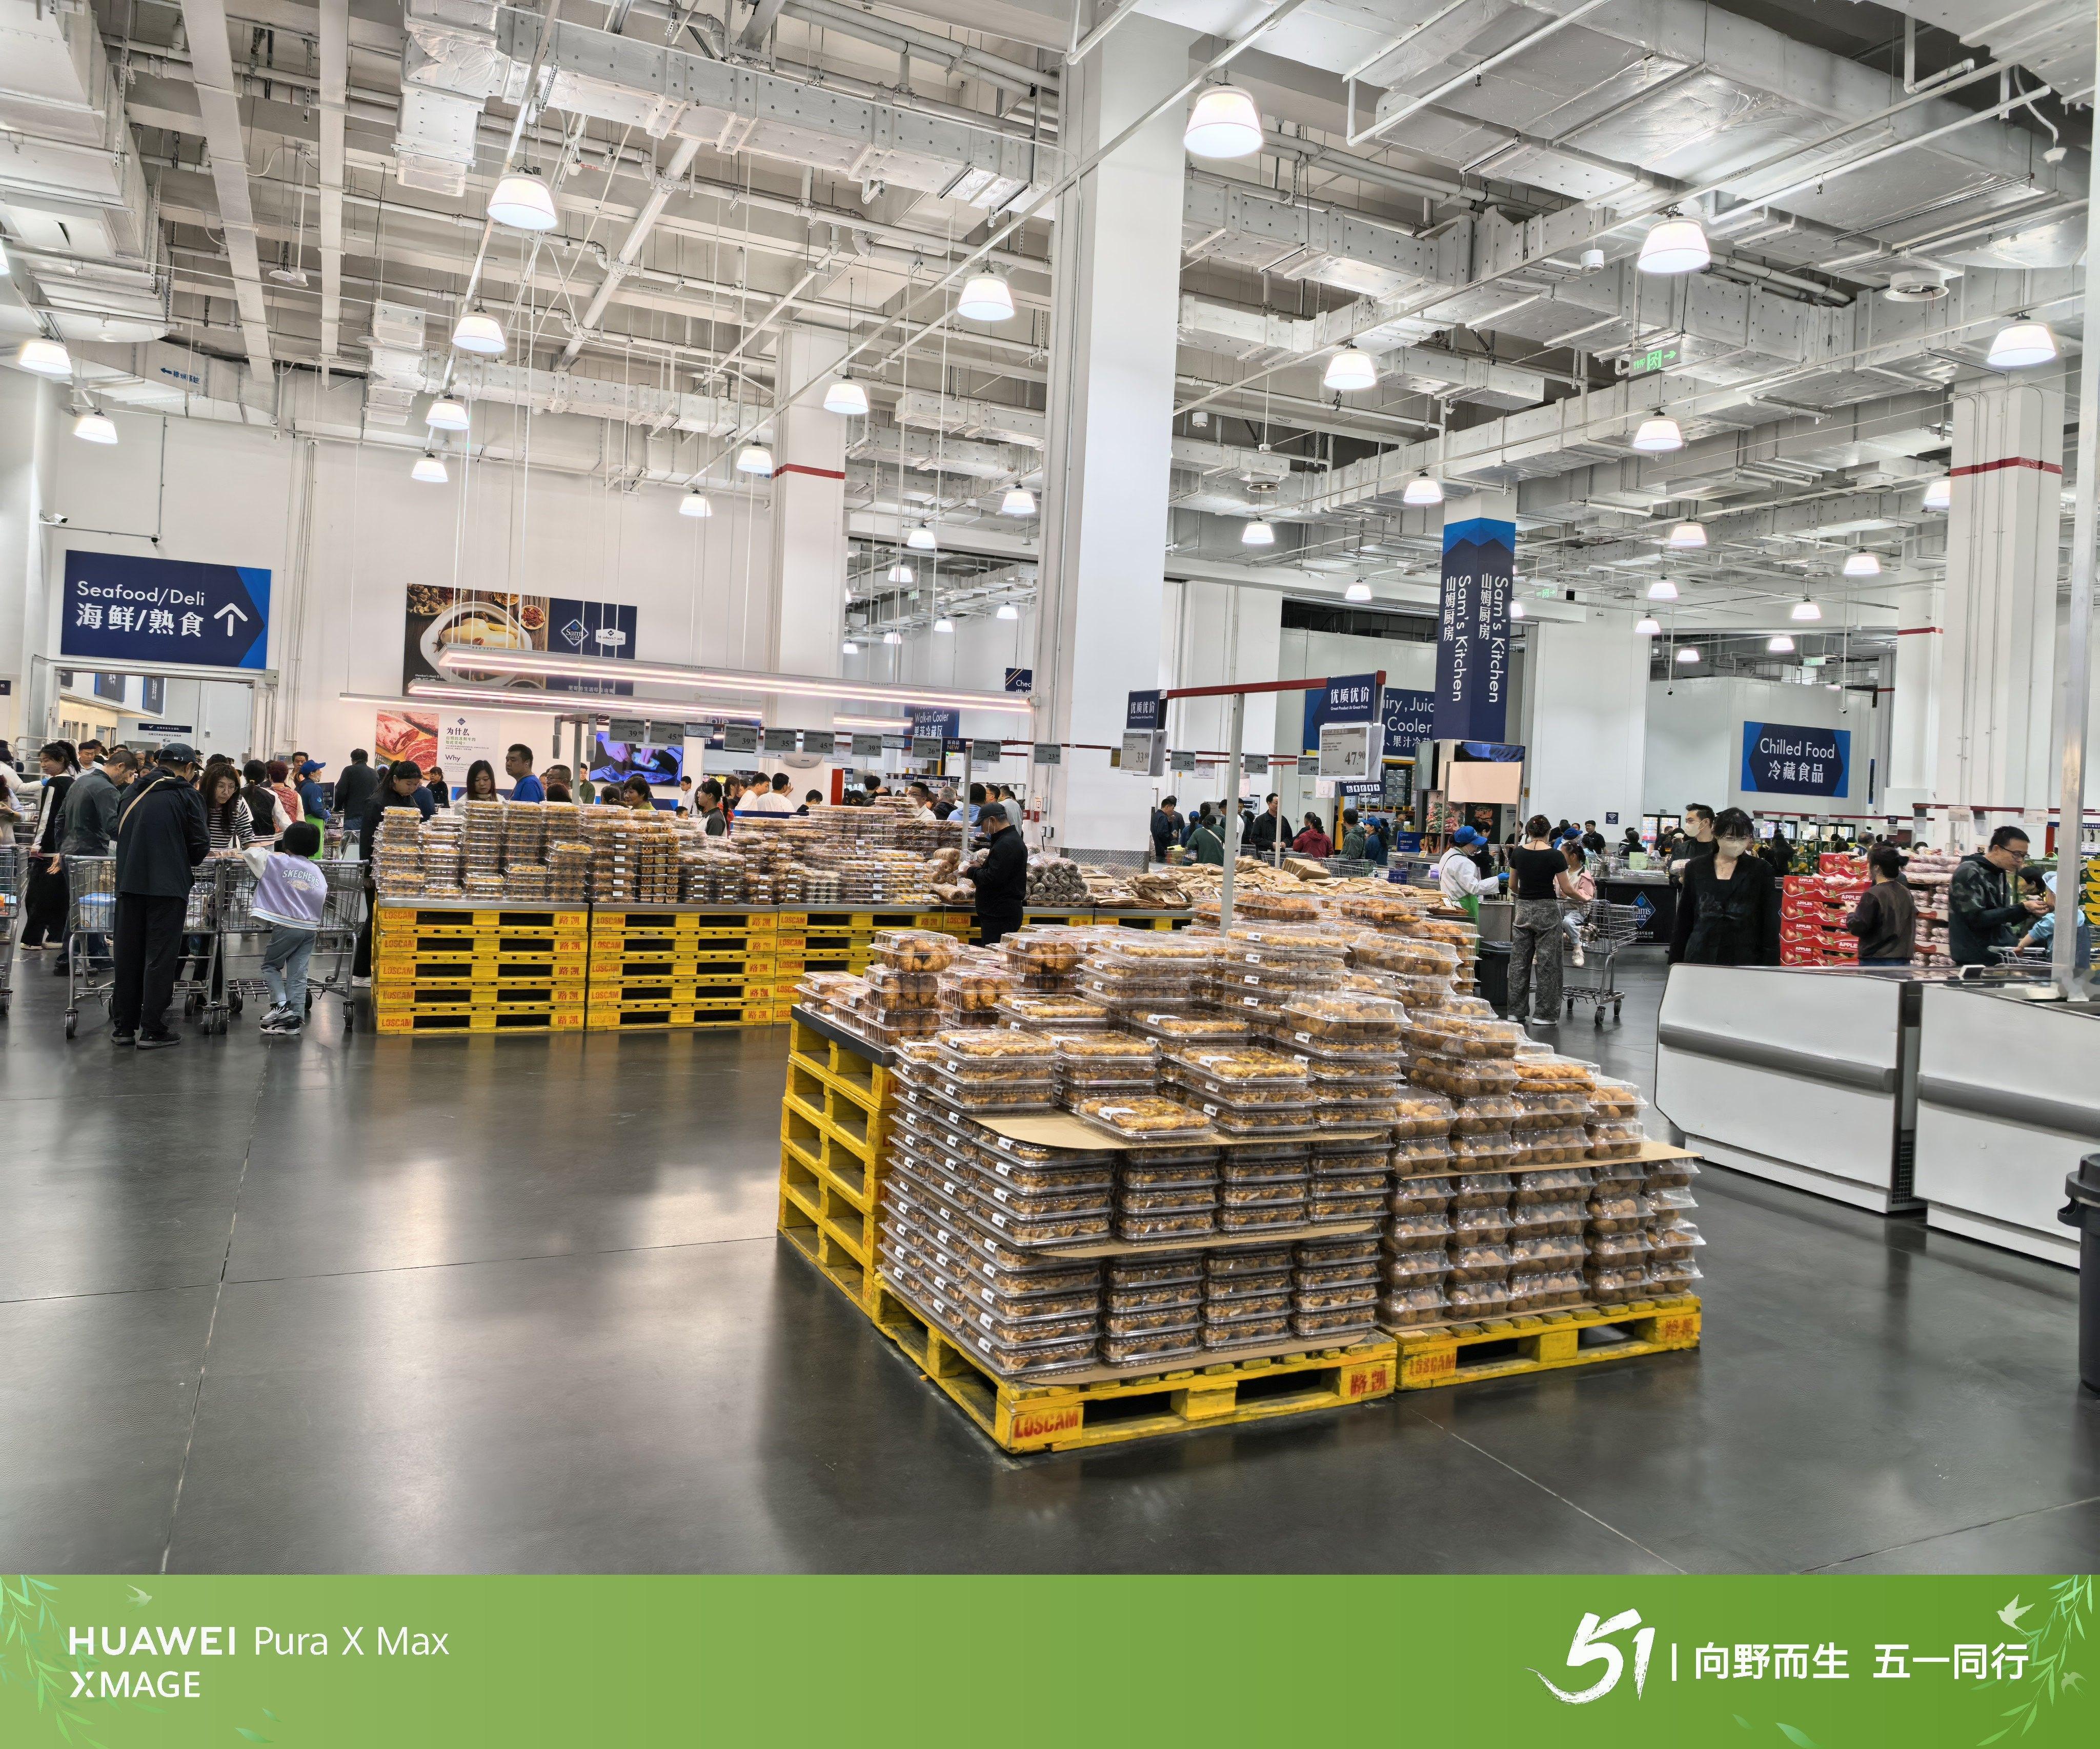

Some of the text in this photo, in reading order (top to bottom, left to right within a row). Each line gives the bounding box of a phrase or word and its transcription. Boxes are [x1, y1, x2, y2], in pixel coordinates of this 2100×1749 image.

[76, 581, 205, 606] Seafood/Deli
[1443, 576, 1456, 641] 山姆厨房
[1479, 573, 1492, 640] 山姆厨房
[76, 602, 204, 637] 海鲜/熟食
[1452, 575, 1471, 701] Sam's Kitchen
[1489, 576, 1508, 702] Sam's Kitchen
[1330, 686, 1369, 704] 优质优价
[915, 710, 949, 723] Walk-in Cooler
[1130, 701, 1155, 714] 优质优价
[447, 727, 470, 736] 为什么
[1387, 717, 1432, 733] Cooler
[445, 754, 461, 762] Why
[1345, 751, 1366, 765] 47.90
[1760, 738, 1834, 759] Chilled Food
[1768, 760, 1824, 783] 冷藏食品
[282, 870, 319, 887] SKECHERS
[777, 984, 799, 993] LOSCA
[1014, 1411, 1078, 1439] LOSCAM
